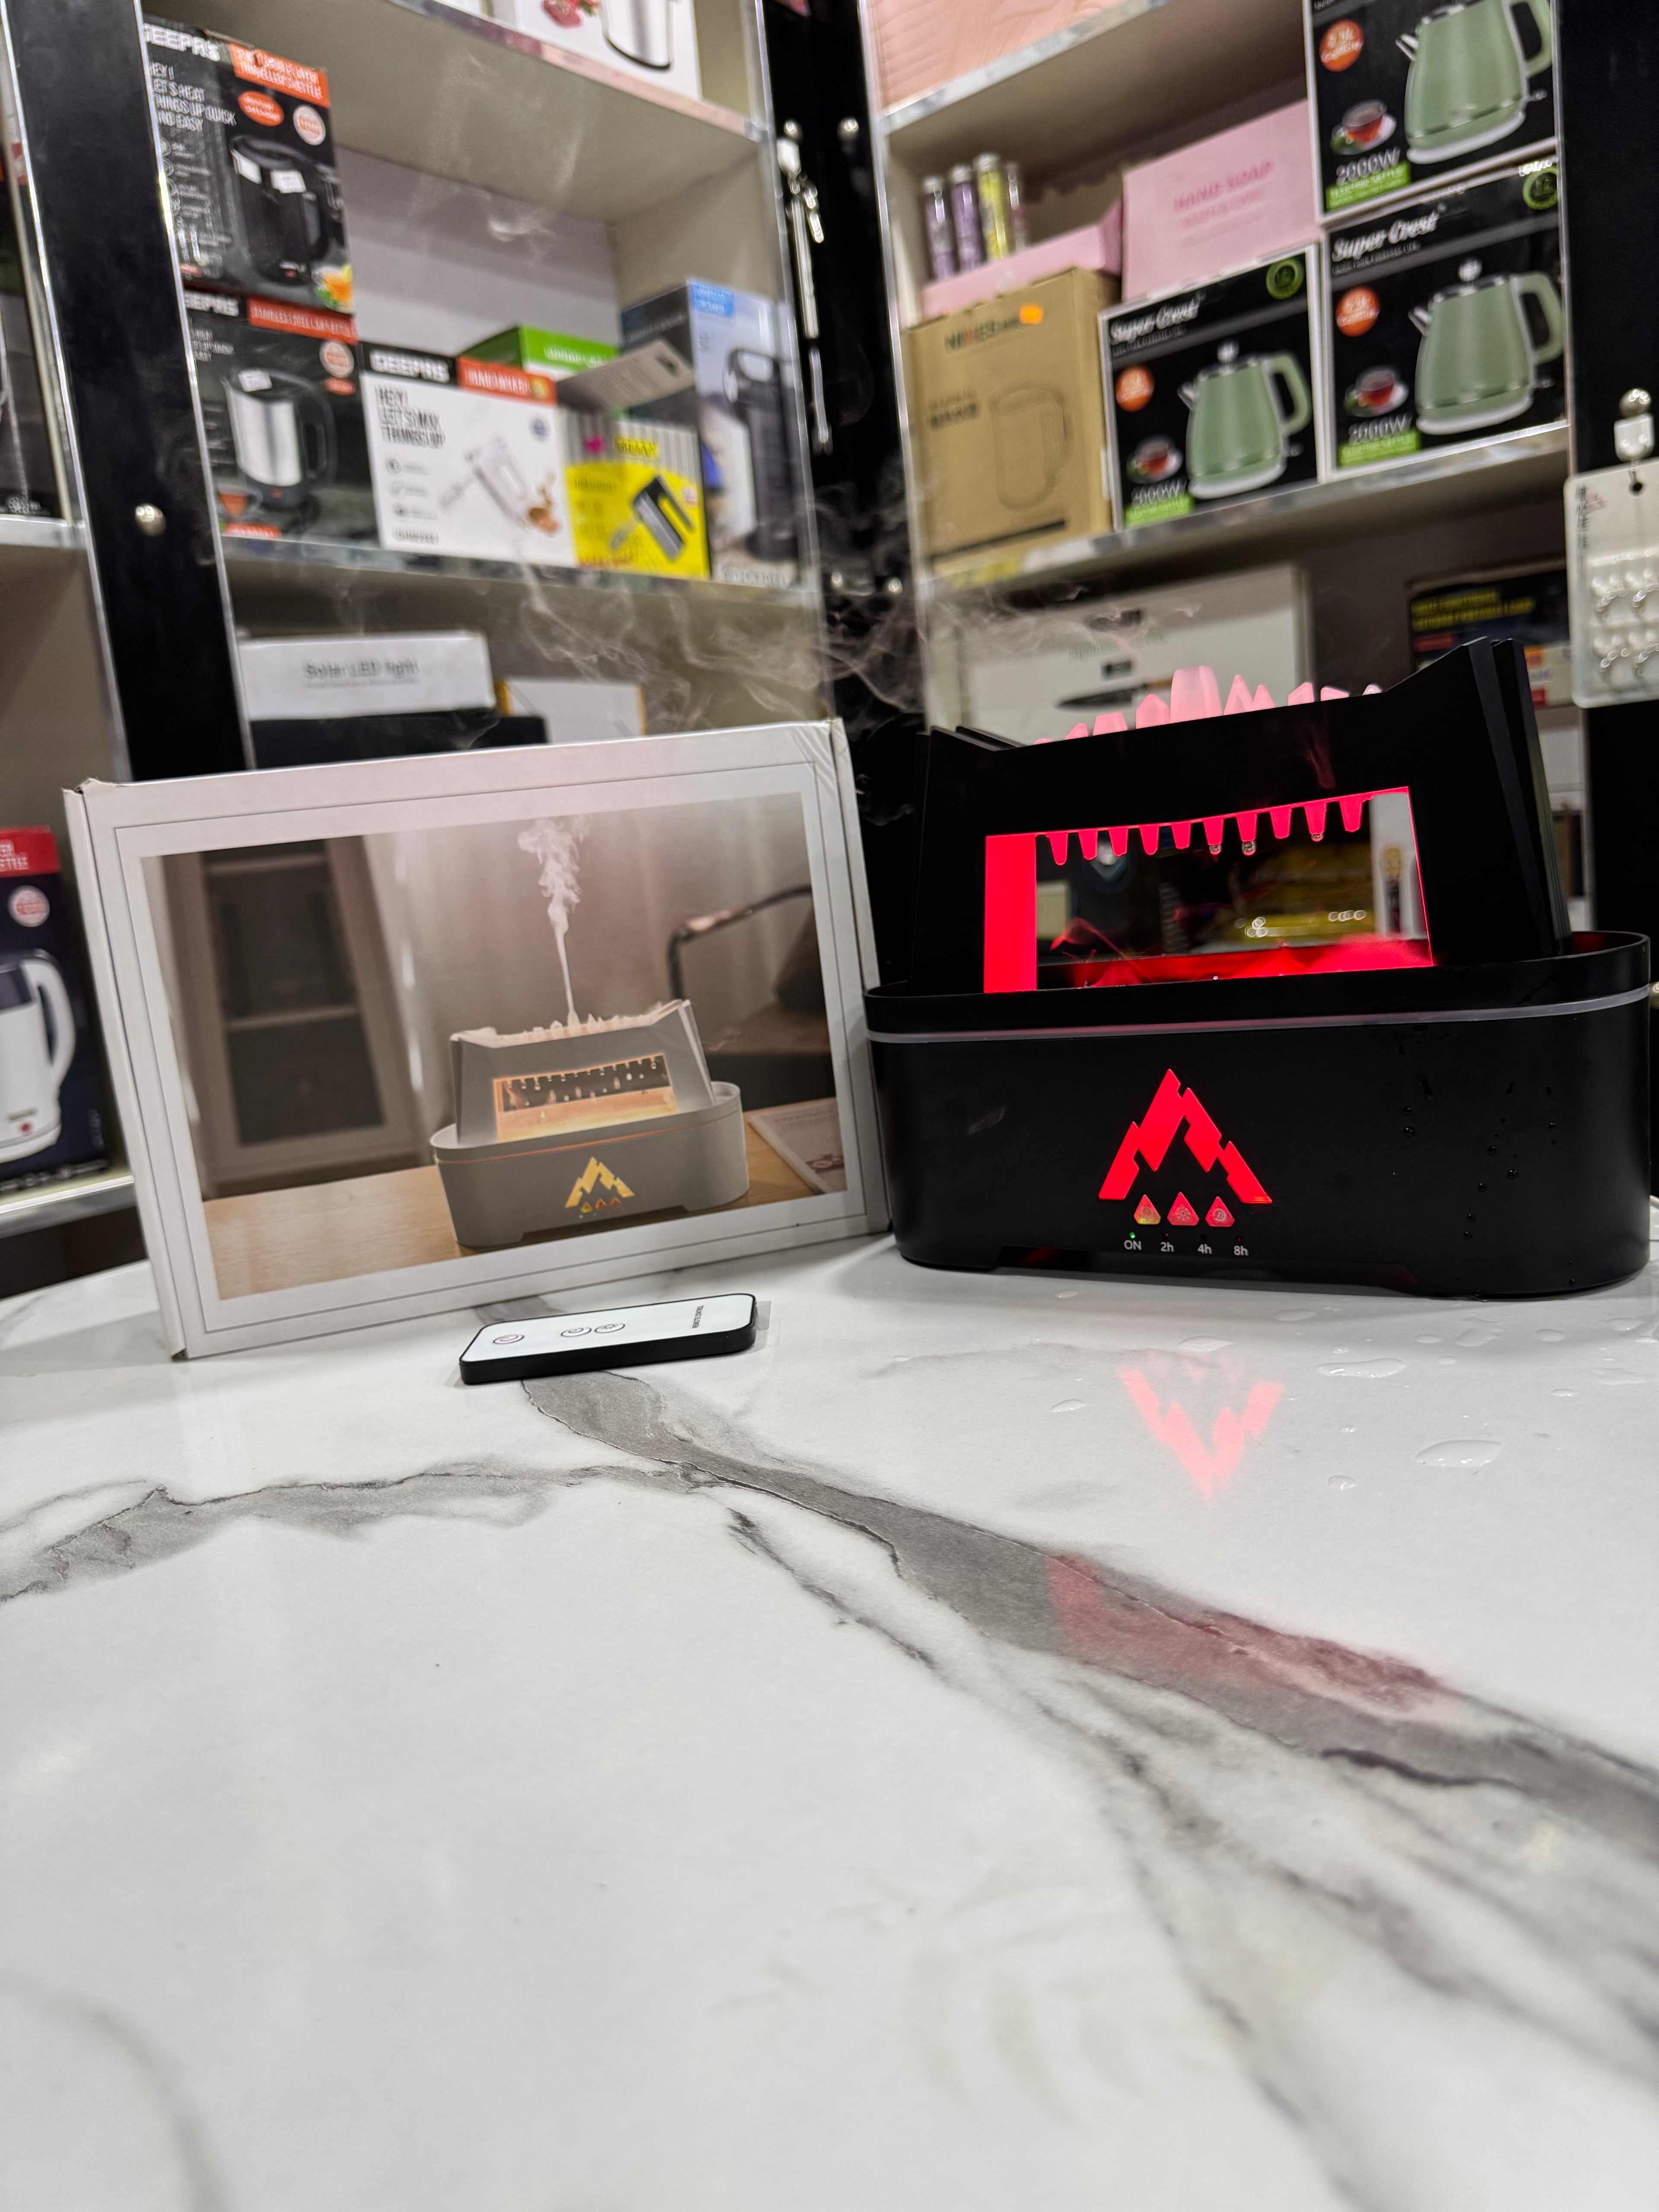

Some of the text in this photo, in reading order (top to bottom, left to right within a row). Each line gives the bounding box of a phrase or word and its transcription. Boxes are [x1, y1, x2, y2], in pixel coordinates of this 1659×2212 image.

[178, 84, 205, 103] HEAT
[175, 113, 203, 132] EASY
[189, 101, 205, 117] UP
[204, 105, 237, 127] QUICK
[1336, 146, 1401, 185] 2000W
[1332, 229, 1388, 262] Super
[184, 291, 239, 317] EEPAS
[369, 348, 451, 384] GEEPAS
[1124, 1239, 1249, 1256] ON 2h 4h 8h
